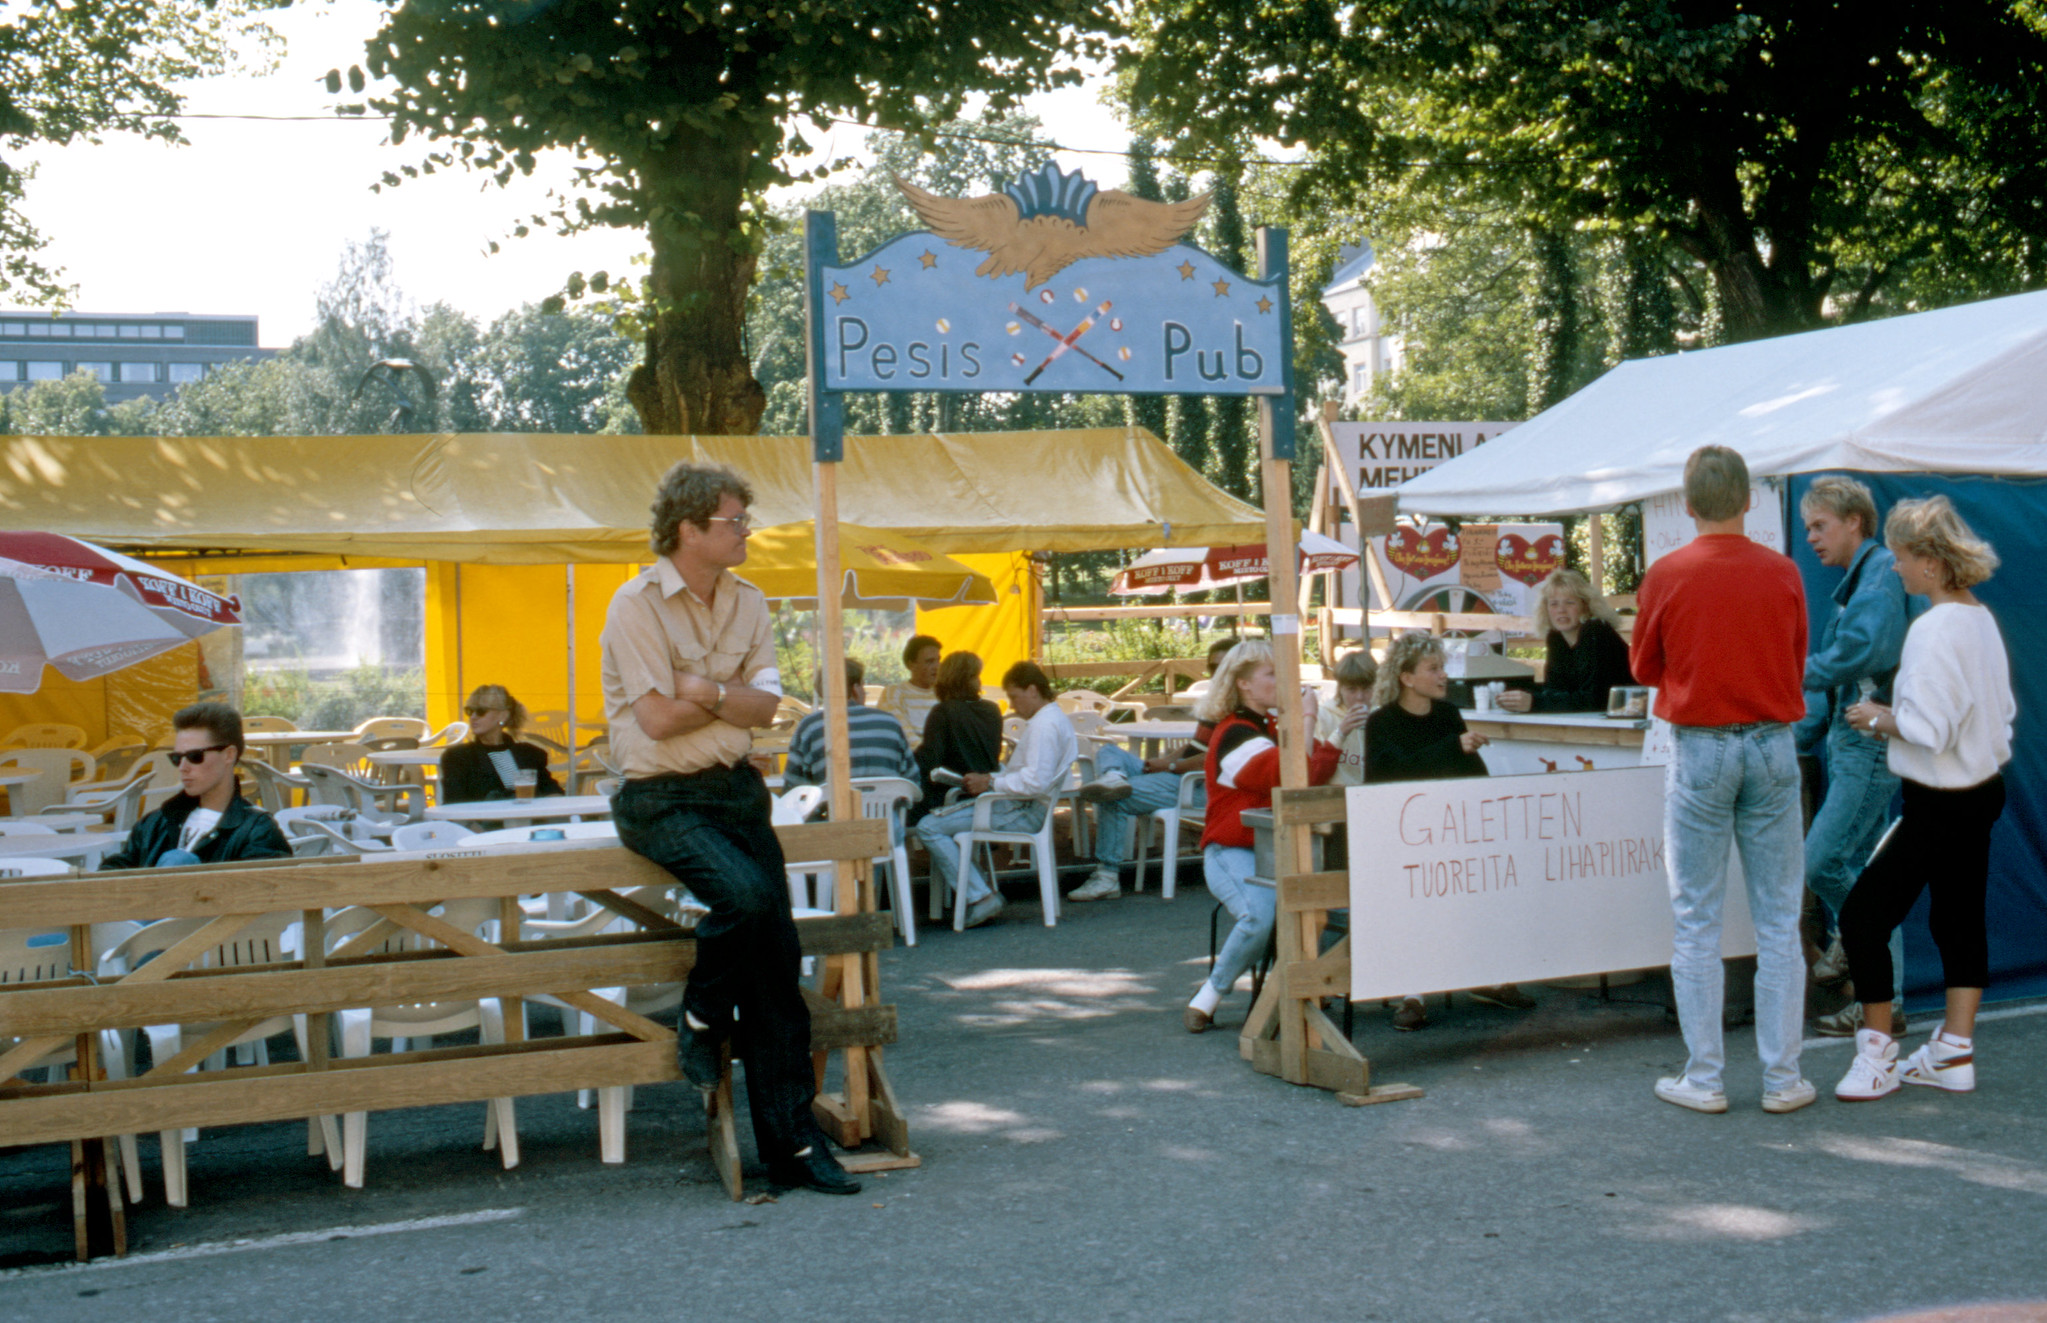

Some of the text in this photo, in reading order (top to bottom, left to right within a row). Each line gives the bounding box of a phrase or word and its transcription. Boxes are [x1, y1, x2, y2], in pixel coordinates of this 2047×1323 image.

[836, 316, 1264, 381] Pesis Pub
[34, 564, 95, 582] OFF
[1218, 558, 1253, 571] KOFF
[136, 576, 178, 597] KOFF
[187, 587, 222, 613] KOFF
[1399, 791, 1582, 846] GALETTEN
[1402, 854, 1518, 899] TUOREITA
